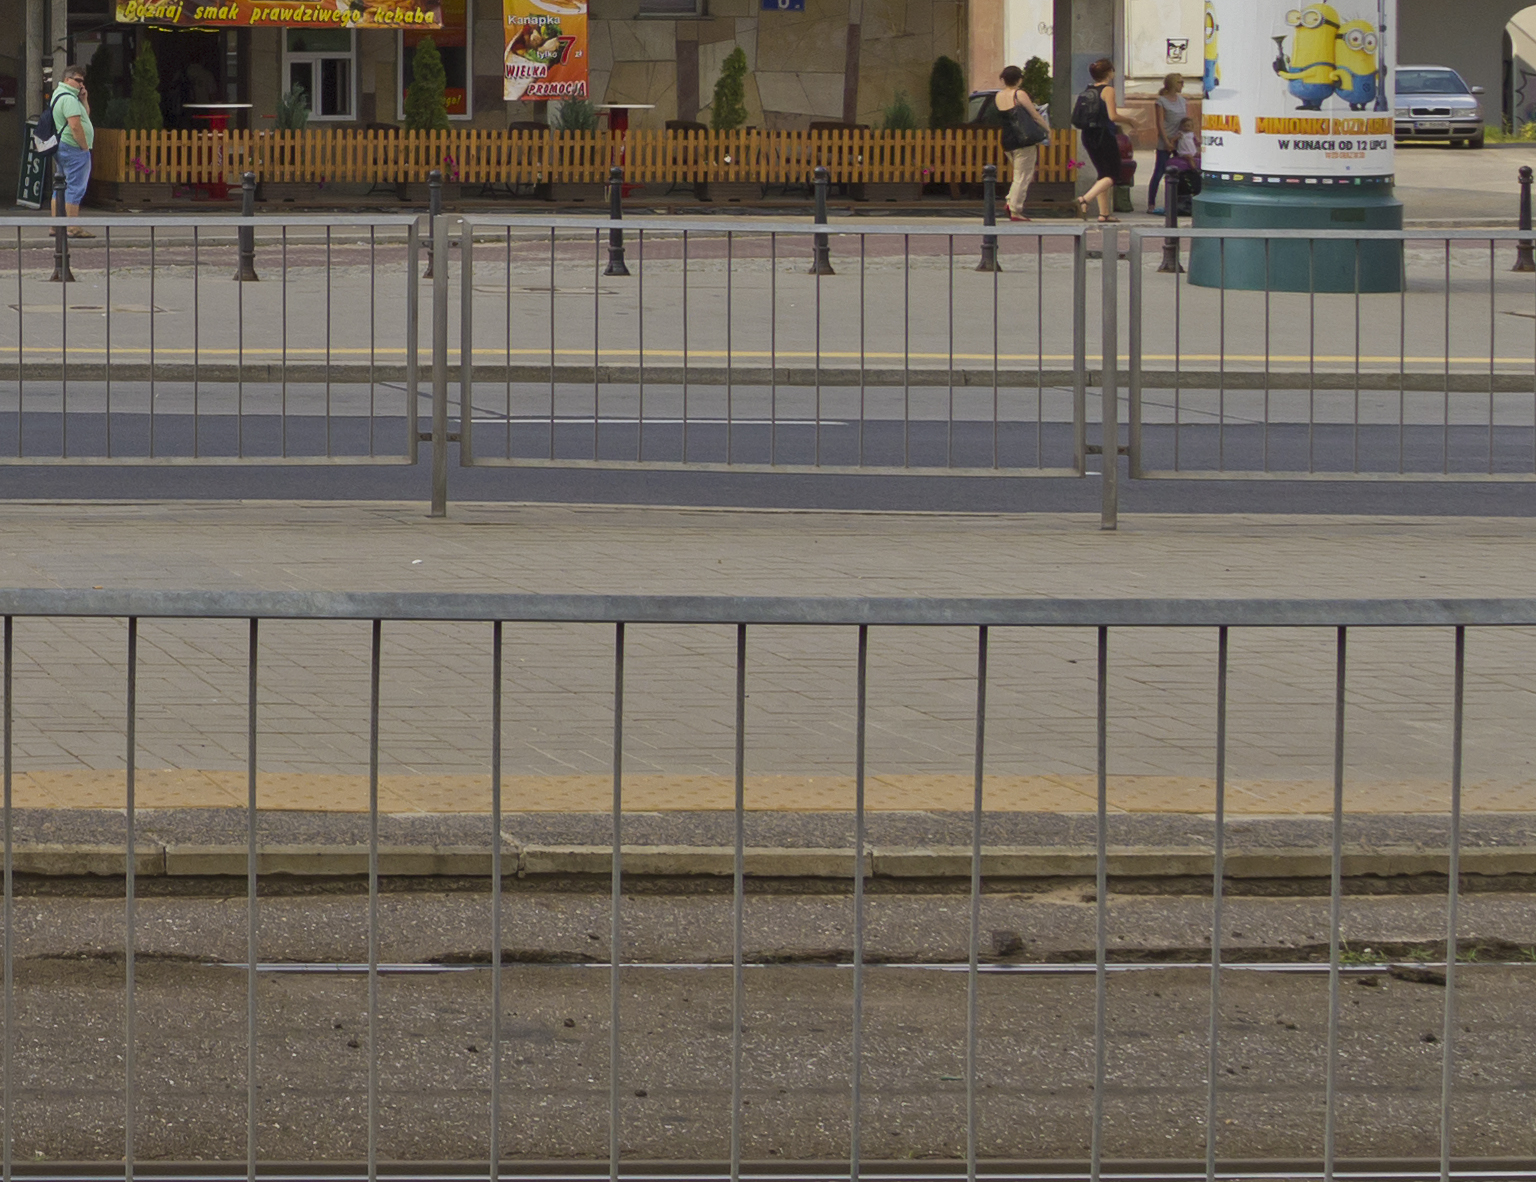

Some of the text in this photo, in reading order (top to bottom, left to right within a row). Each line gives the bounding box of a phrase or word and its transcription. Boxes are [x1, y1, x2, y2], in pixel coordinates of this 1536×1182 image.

[124, 0, 435, 27] Poznaj smak prawdziwego kebaba
[507, 14, 561, 26] Kanapka
[536, 50, 558, 60] tylko
[557, 35, 577, 66] 7
[505, 64, 547, 78] WIELKA
[527, 81, 587, 97] PROMOCJA
[1255, 117, 1331, 135] MINIONKI
[1278, 139, 1289, 150] W
[1293, 139, 1335, 151] KINACH
[1339, 139, 1353, 151] OD
[1356, 139, 1368, 150] 12
